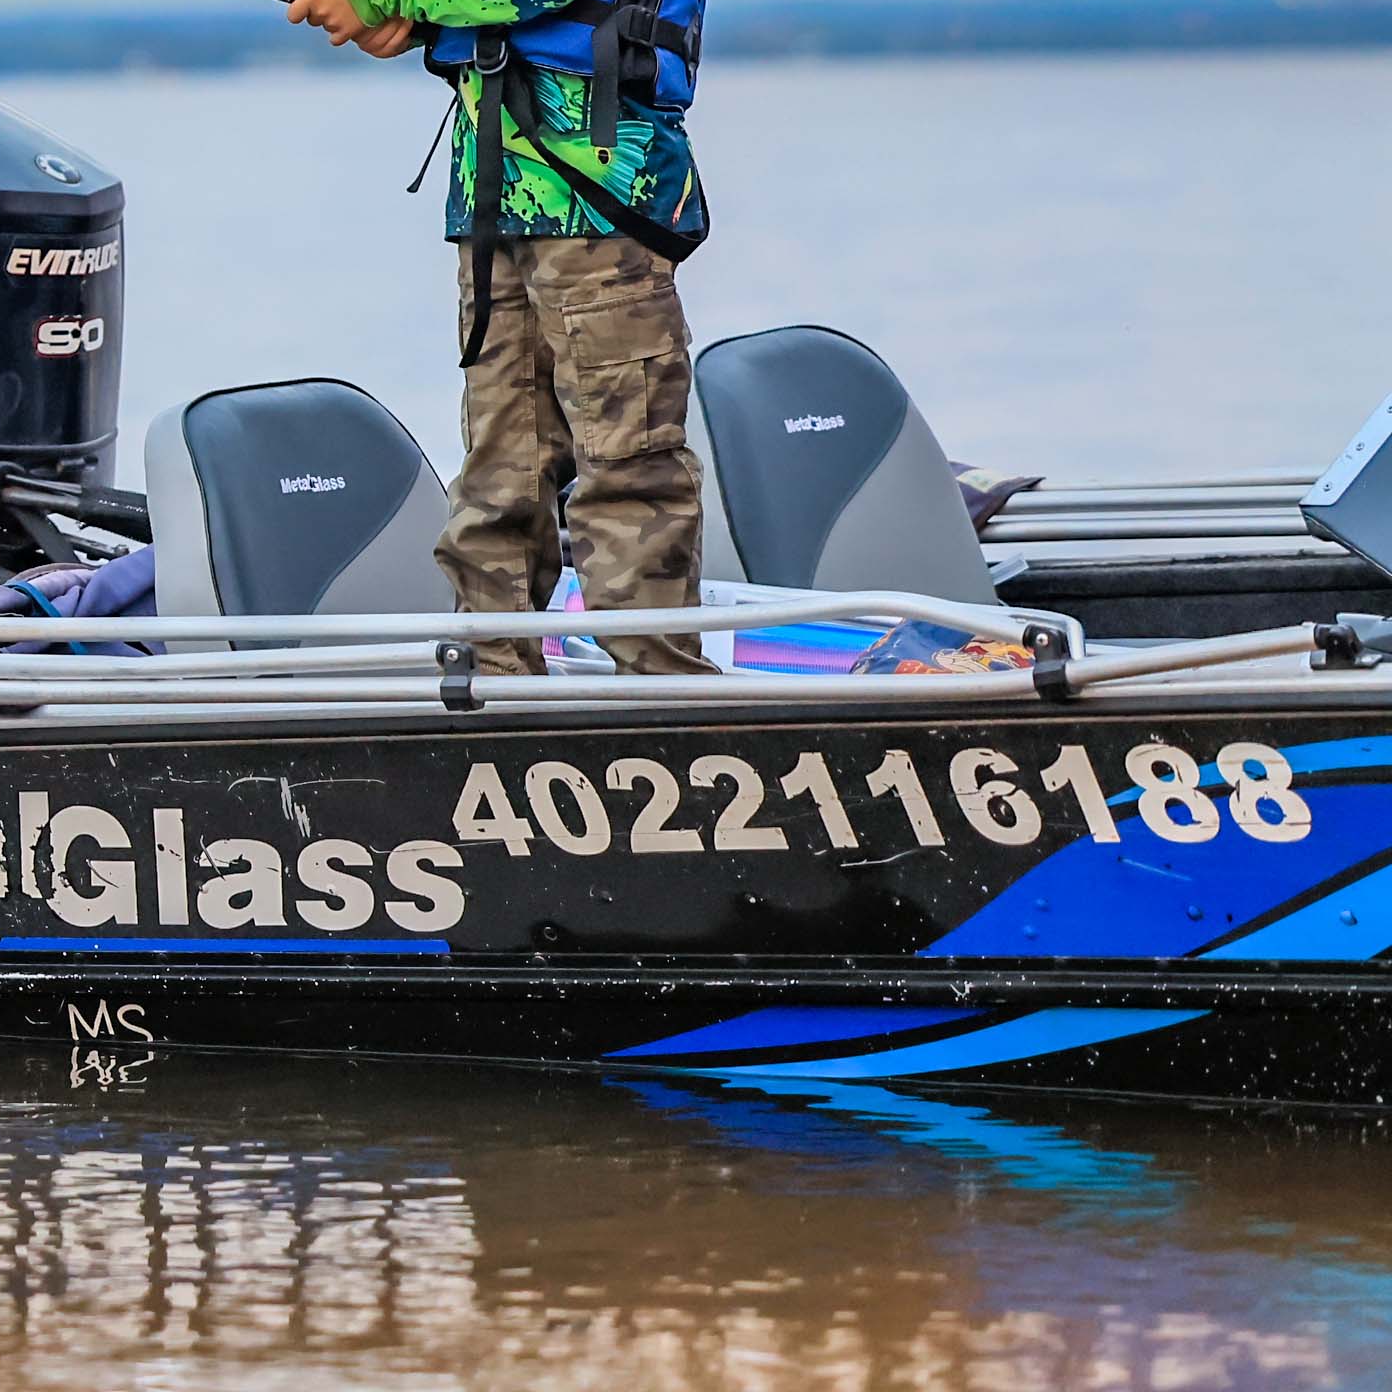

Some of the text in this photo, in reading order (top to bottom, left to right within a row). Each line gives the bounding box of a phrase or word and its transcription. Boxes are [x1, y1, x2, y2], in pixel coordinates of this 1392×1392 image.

[6, 240, 118, 275] EVINRUDE
[452, 743, 1312, 857] 4022116188
[67, 999, 153, 1042] MS
